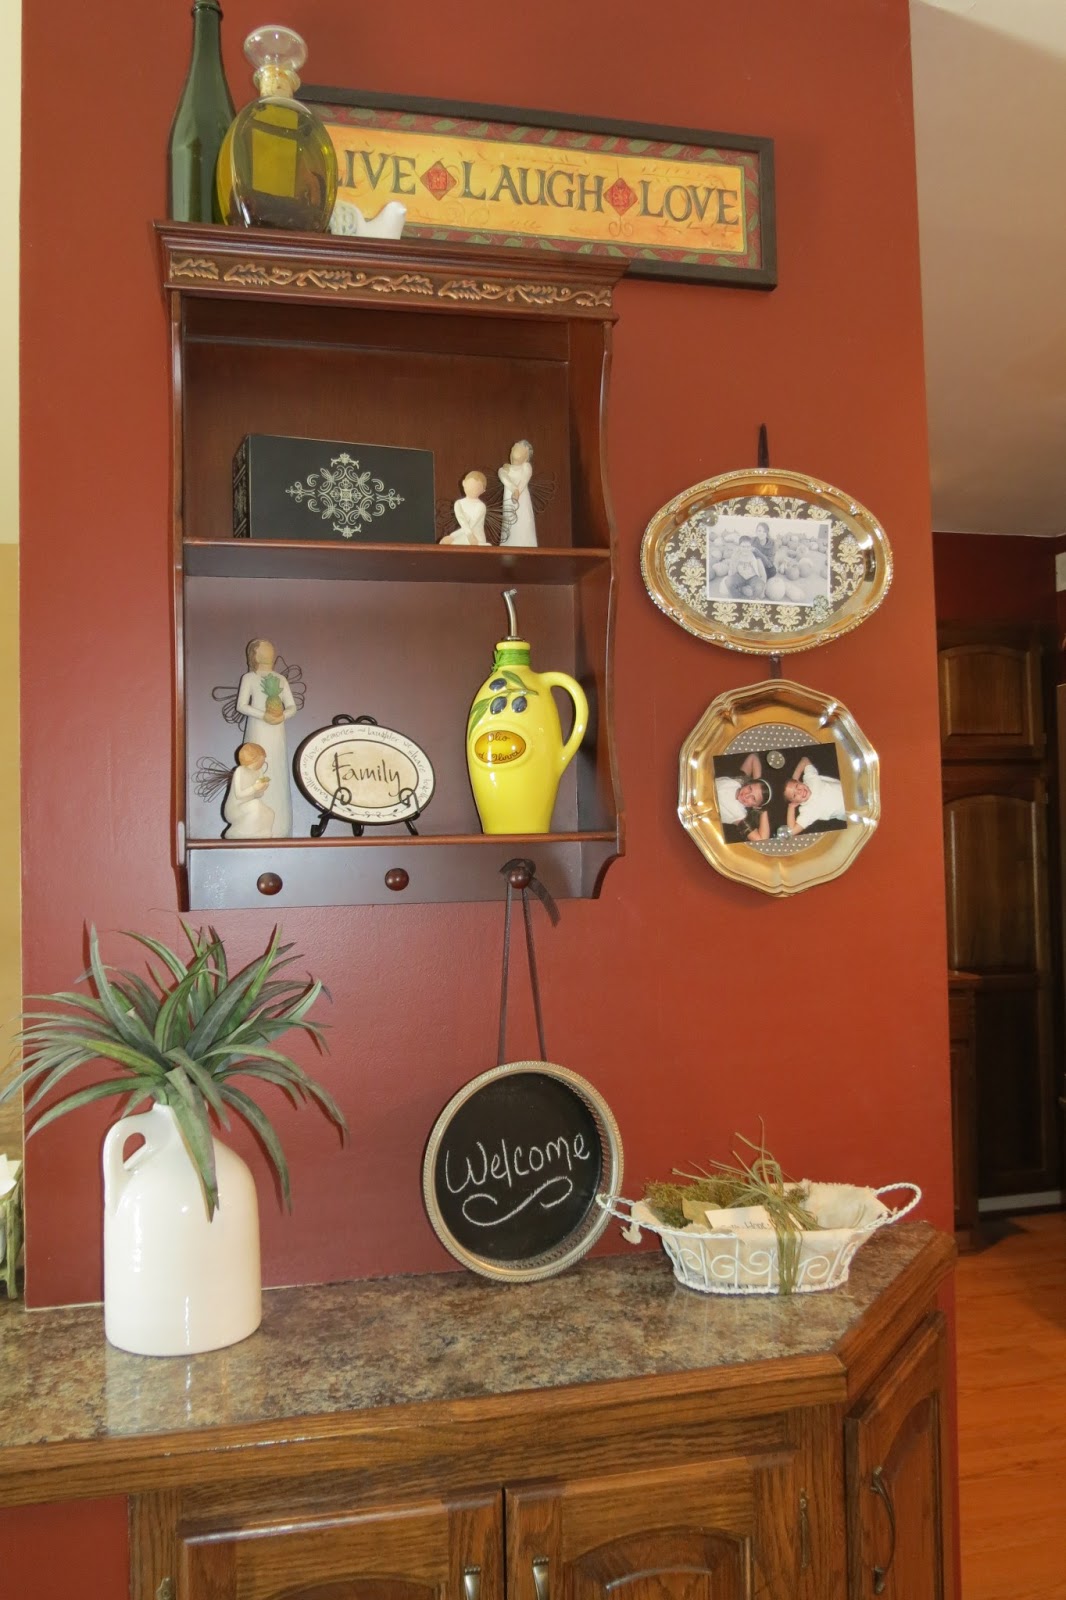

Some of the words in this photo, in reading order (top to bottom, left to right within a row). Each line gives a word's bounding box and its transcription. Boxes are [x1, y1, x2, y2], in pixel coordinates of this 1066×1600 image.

[337, 149, 416, 195] IVE
[460, 160, 605, 213] LAUGH
[637, 178, 742, 227] LOVE
[331, 751, 401, 797] Family
[367, 728, 400, 743] laughter
[408, 749, 427, 774] share
[444, 1132, 591, 1194] Welcome
